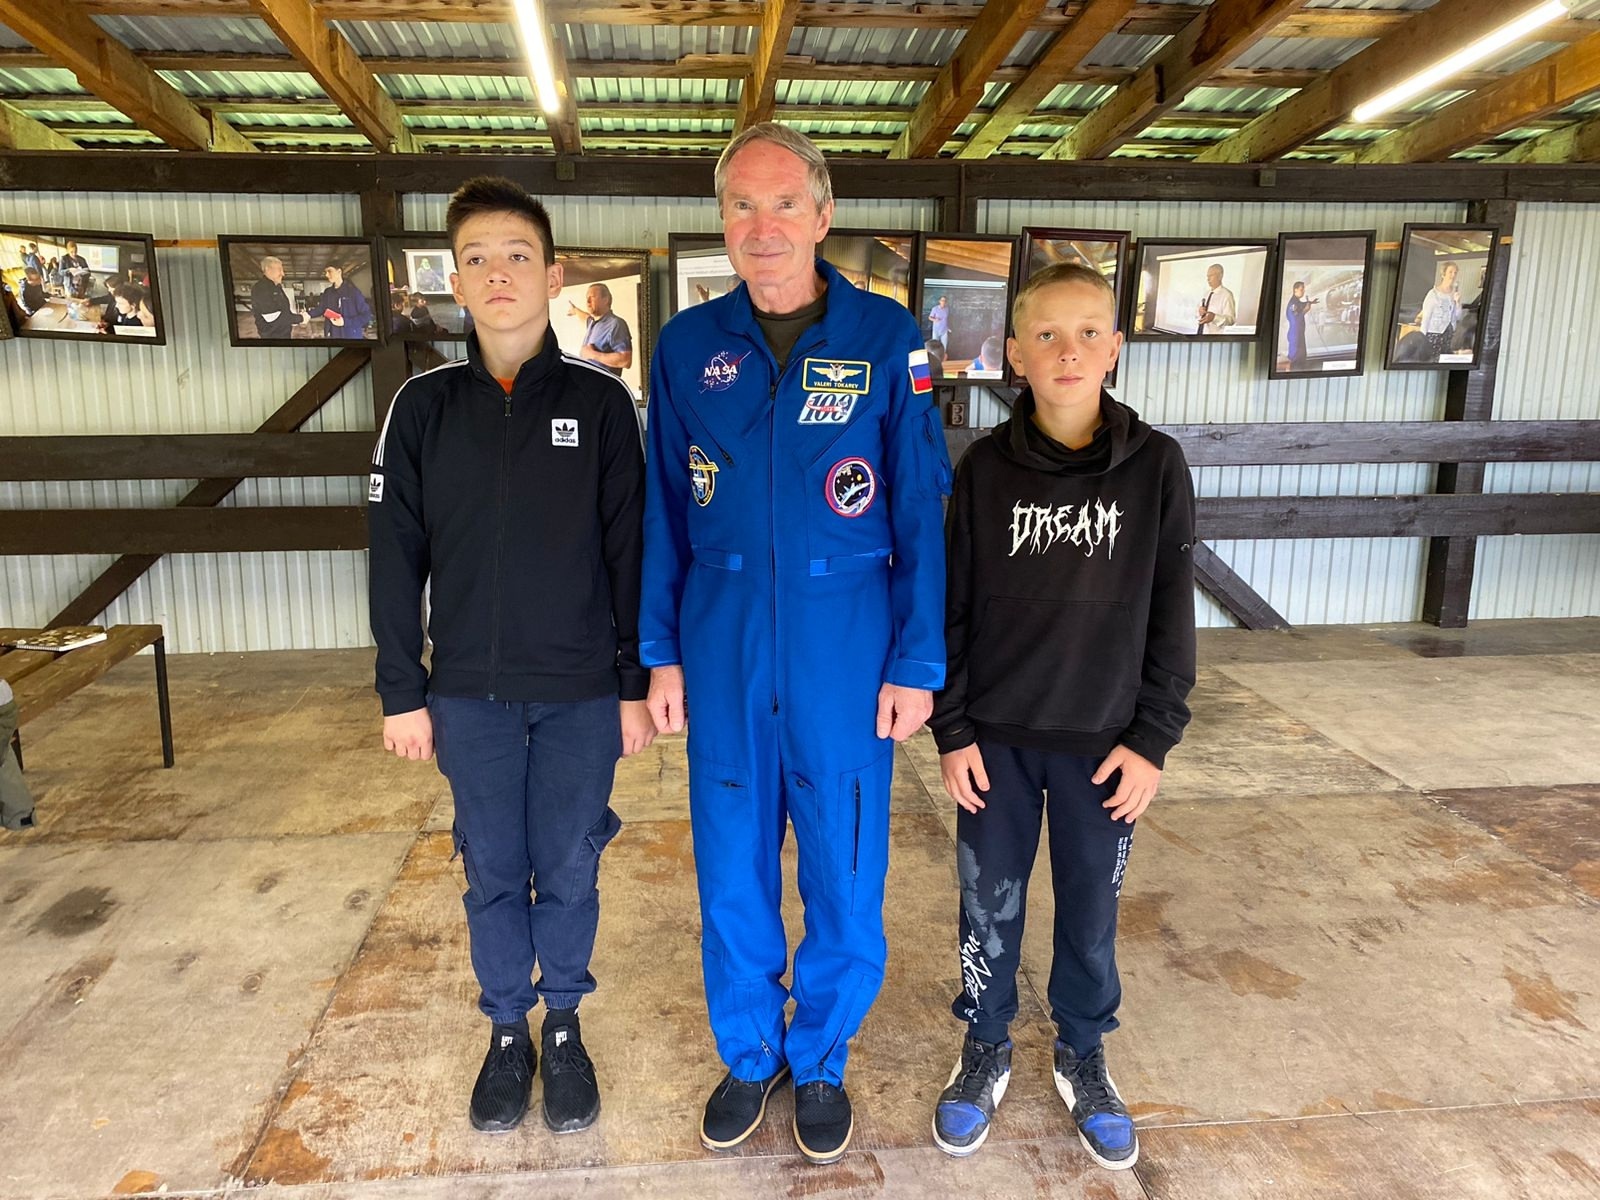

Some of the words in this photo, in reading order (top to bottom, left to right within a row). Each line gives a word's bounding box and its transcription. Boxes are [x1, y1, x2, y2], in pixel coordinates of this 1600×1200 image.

[704, 364, 738, 378] NASA
[801, 393, 854, 422] 100
[1008, 496, 1125, 560] DREAM
